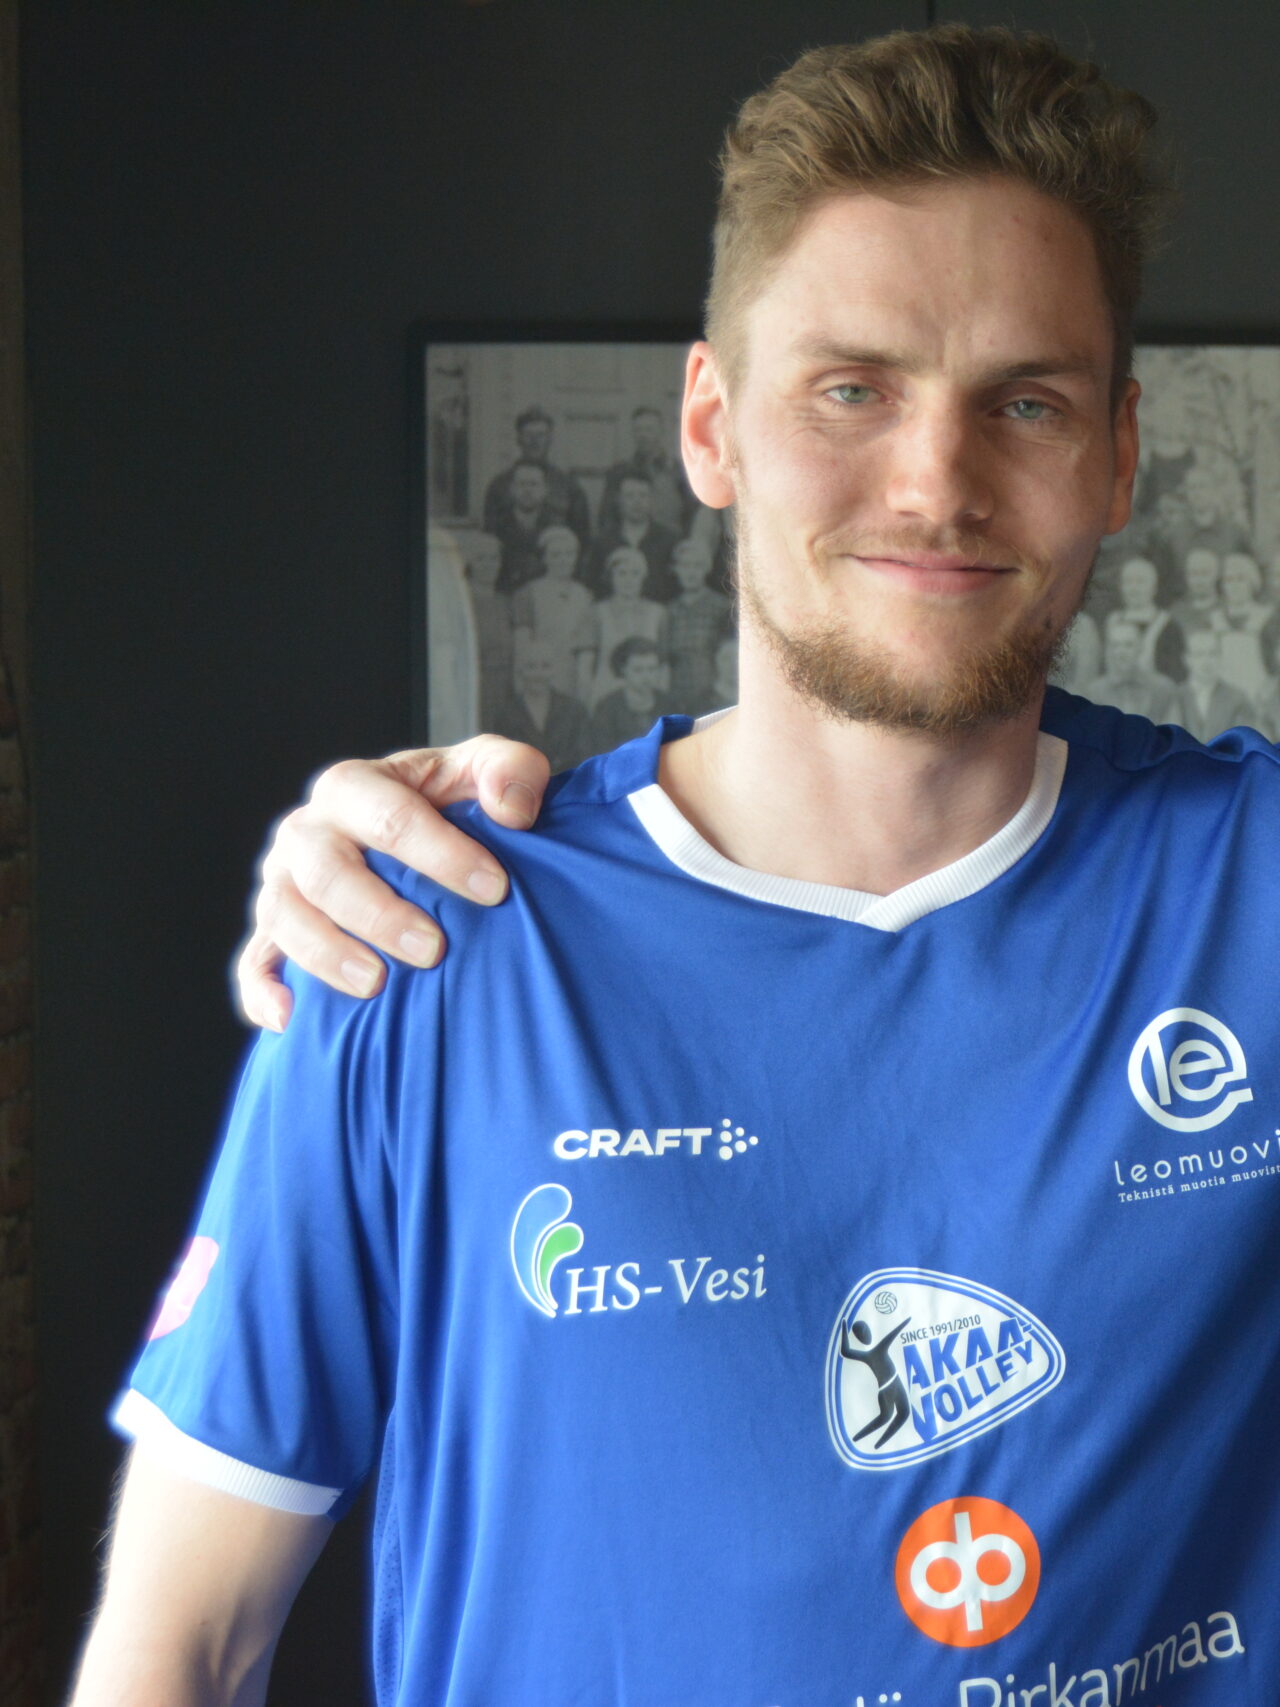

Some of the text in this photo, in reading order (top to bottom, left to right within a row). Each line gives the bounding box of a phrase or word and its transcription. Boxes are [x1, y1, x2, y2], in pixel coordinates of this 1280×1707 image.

[553, 1127, 713, 1160] CRAFT
[1117, 1183, 1175, 1203] Teknistä
[1180, 1175, 1226, 1192] muotia
[564, 1253, 767, 1315] HS-Vesi
[901, 1314, 982, 1345] SINCE 1991/2010
[911, 1340, 1034, 1443] VOLLEY
